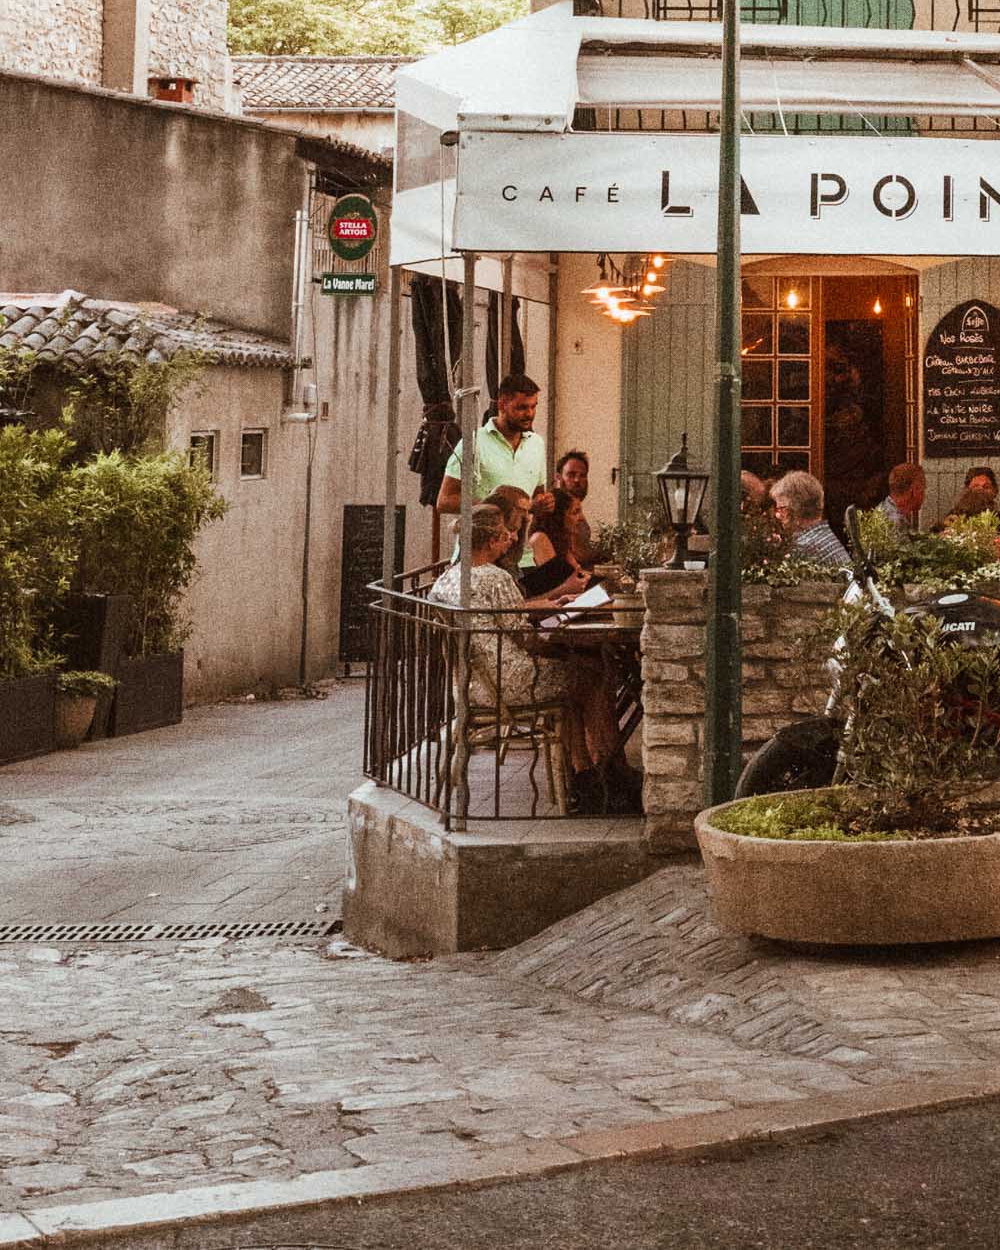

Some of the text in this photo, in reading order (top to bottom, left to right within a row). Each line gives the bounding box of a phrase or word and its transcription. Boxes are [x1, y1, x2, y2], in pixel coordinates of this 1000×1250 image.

[502, 183, 619, 203] CAFÉ
[323, 278, 332, 289] La
[333, 278, 354, 290] Vanne
[942, 621, 976, 632] UCATI
